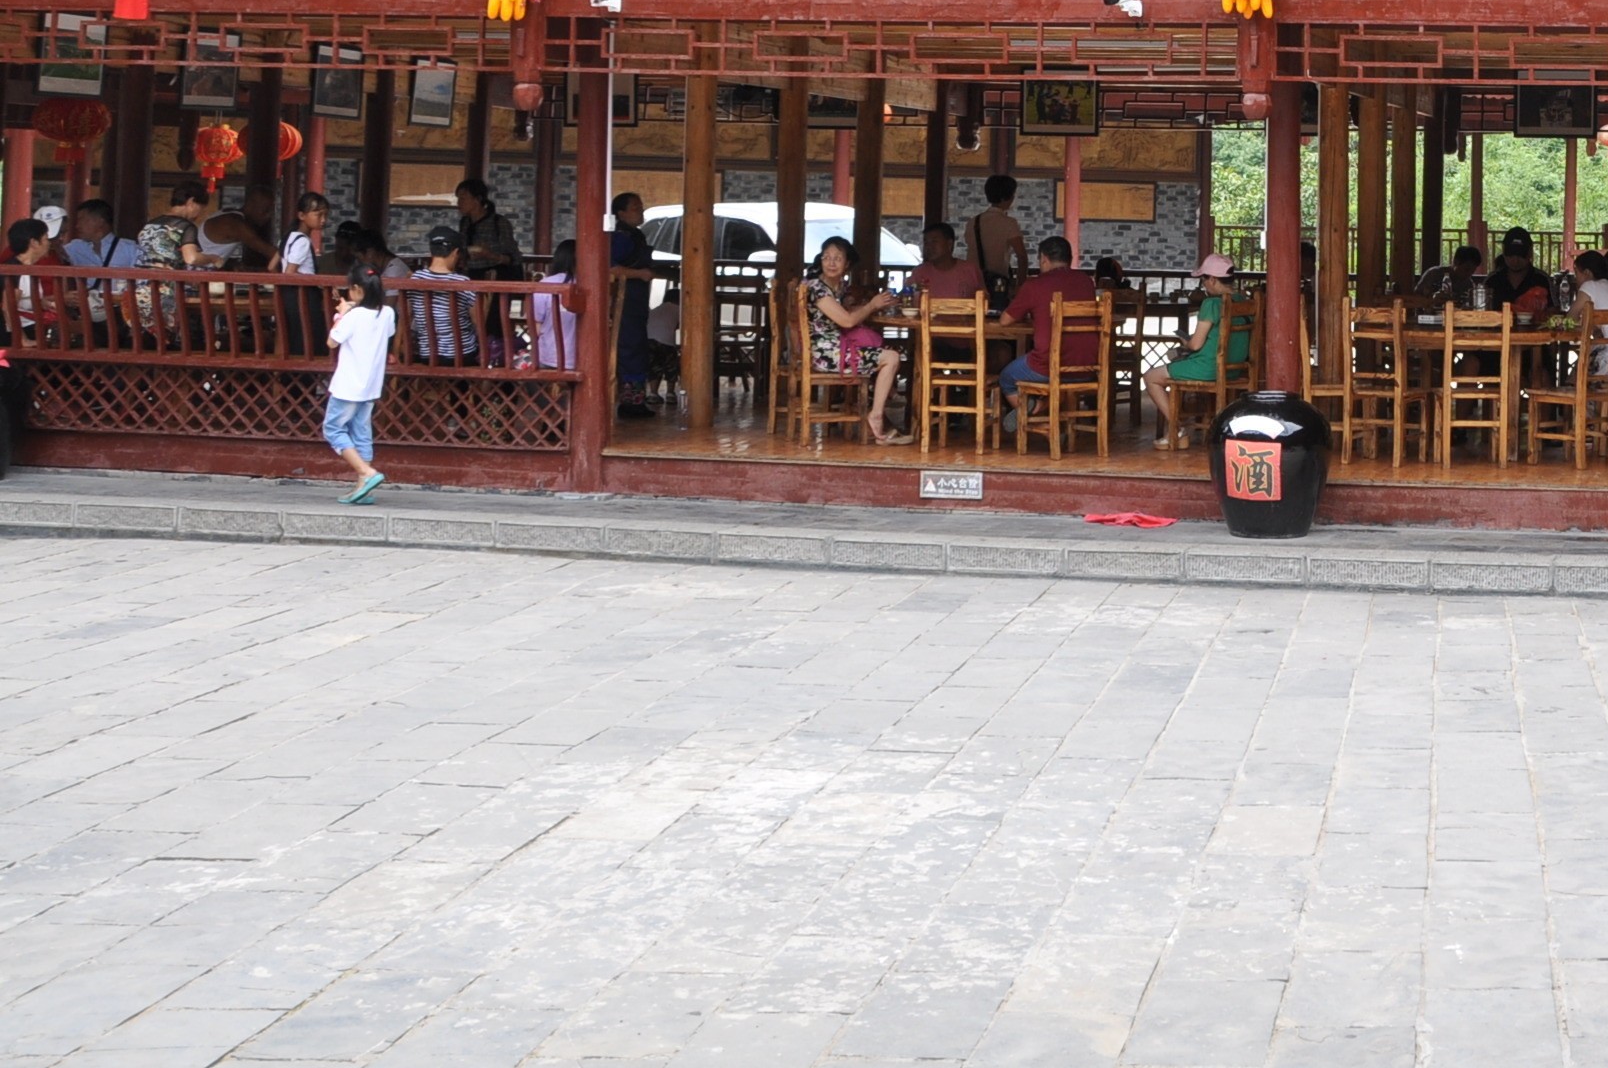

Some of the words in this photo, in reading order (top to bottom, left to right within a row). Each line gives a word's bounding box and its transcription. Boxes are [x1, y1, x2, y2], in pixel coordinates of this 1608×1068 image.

[937, 477, 978, 488] 小心台阶
[1230, 444, 1275, 498] 酒
